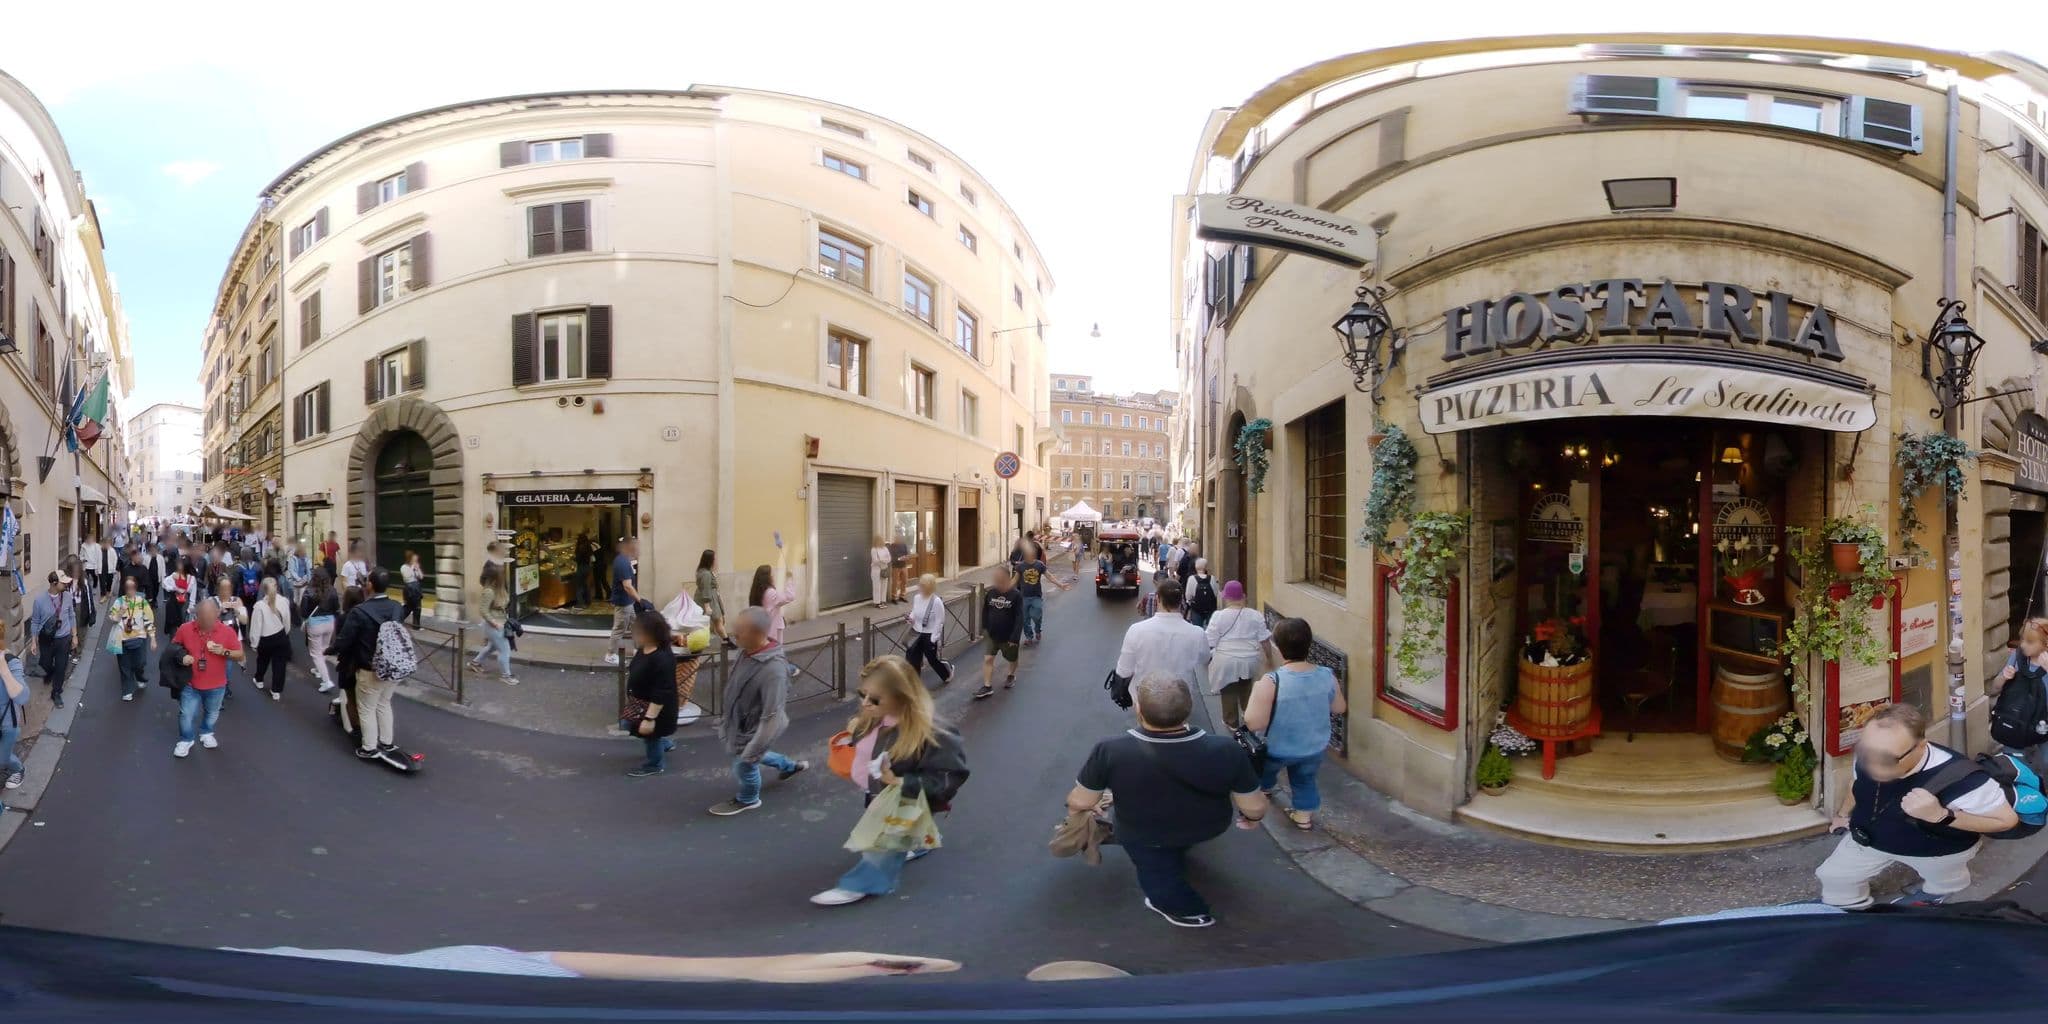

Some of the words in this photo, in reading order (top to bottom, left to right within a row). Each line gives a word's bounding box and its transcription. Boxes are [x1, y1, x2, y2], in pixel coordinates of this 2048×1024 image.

[1226, 196, 1359, 236] Ristorante
[1245, 215, 1346, 249] Pizzeria
[1441, 278, 1846, 363] HOSTARIA
[1434, 371, 1615, 427] PIZZERIA
[1633, 375, 1696, 407] La
[1703, 379, 1857, 426] Scalinata
[515, 493, 570, 503] GELATERIA
